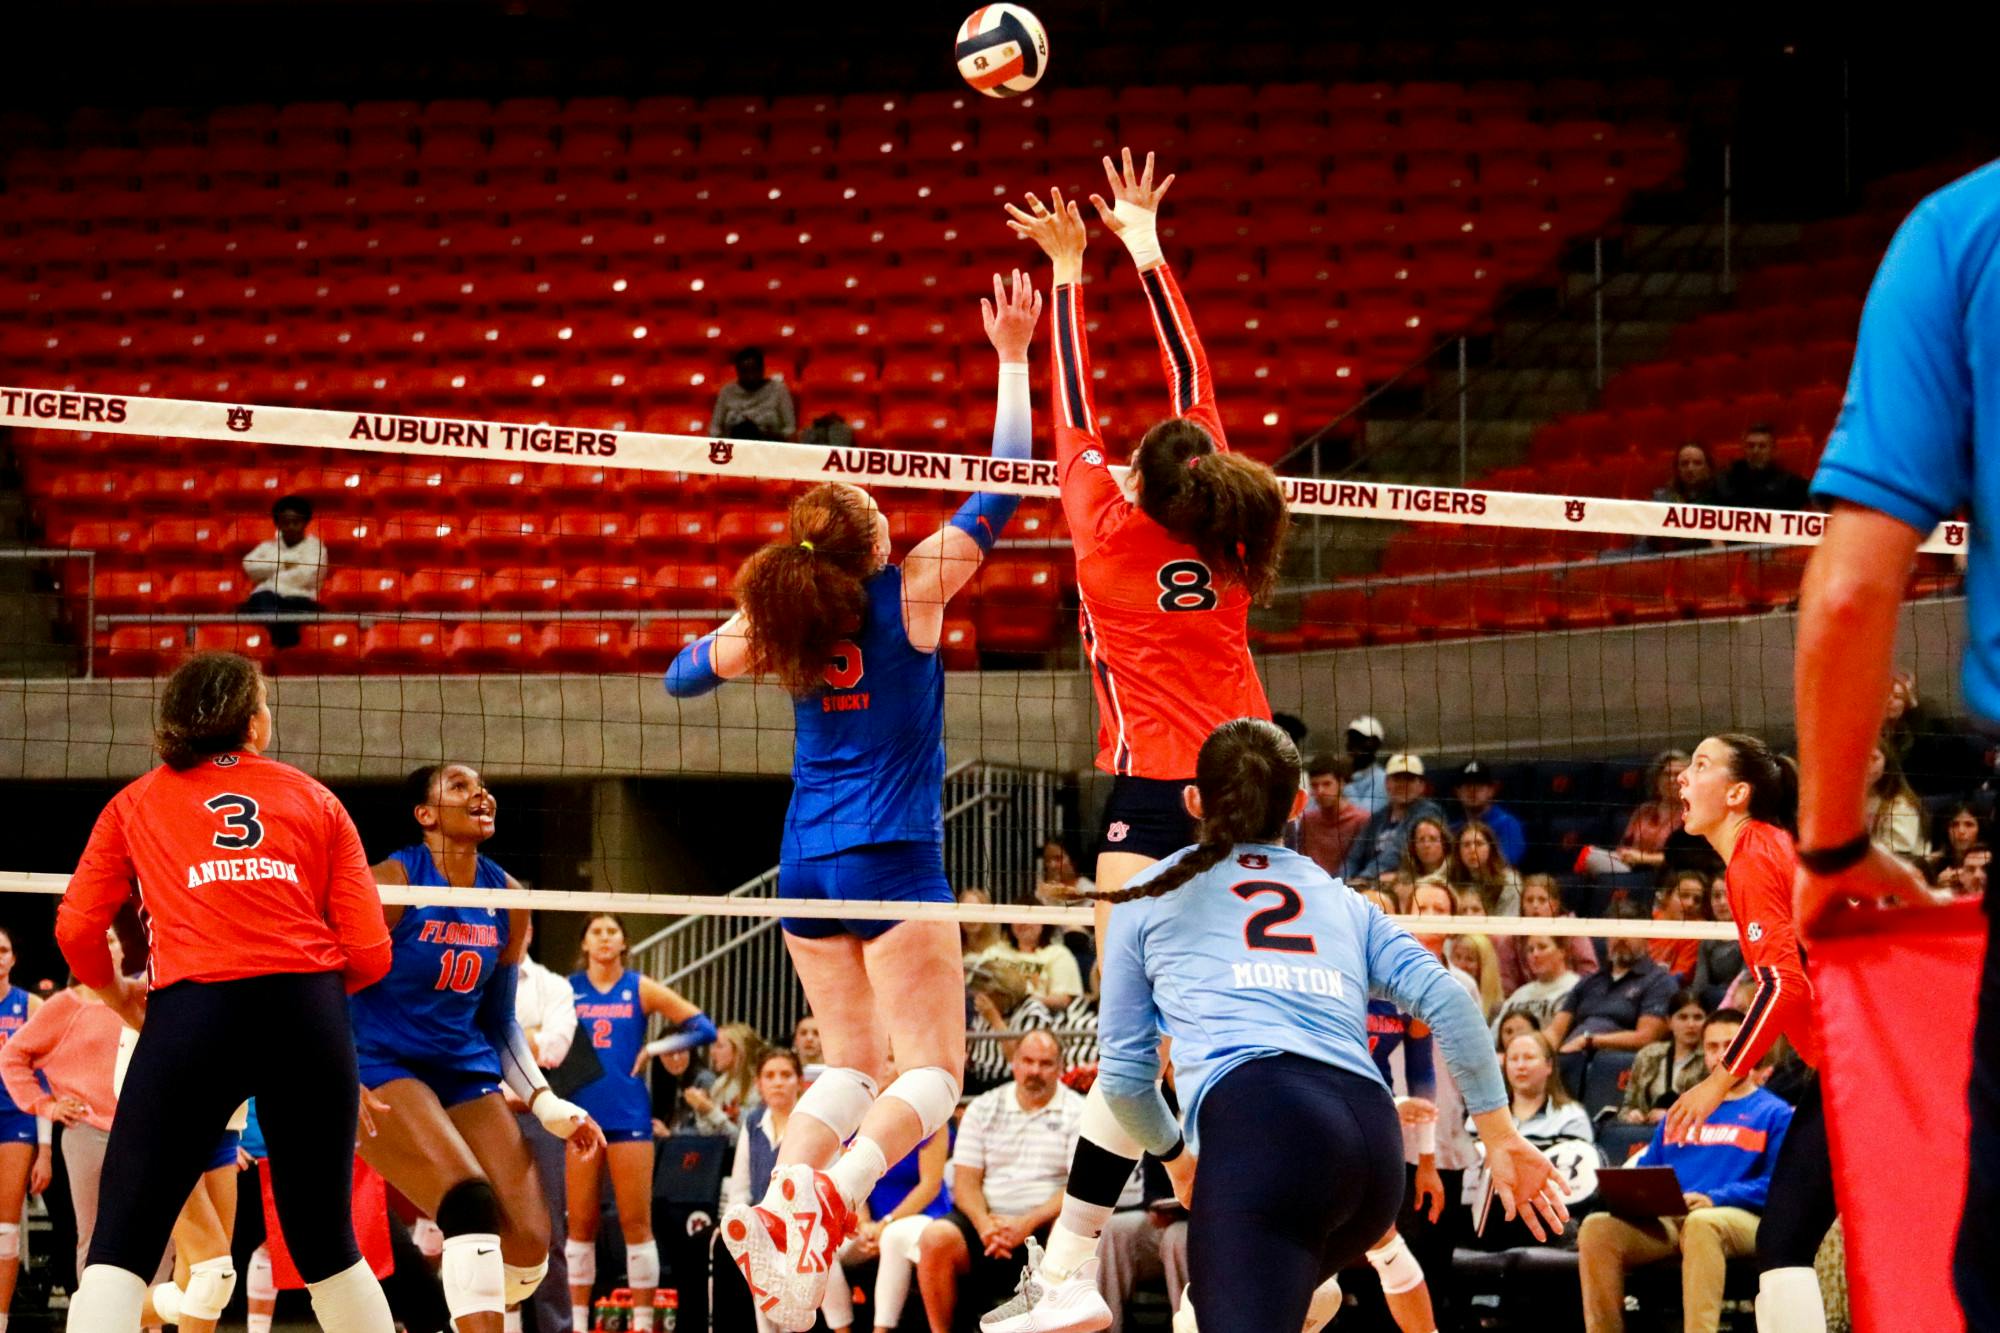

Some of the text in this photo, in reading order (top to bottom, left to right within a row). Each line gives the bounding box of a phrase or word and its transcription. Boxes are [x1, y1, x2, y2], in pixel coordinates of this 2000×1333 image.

[1, 390, 127, 423] TIGERS
[349, 415, 618, 456] AUBURN TIGERS
[822, 449, 950, 480] AUBURN
[1280, 481, 1488, 515] UBURN TIGERS
[1662, 506, 1829, 537] AUBURN TIG
[1157, 559, 1217, 612] 8
[823, 692, 870, 712] STUCKY
[203, 793, 264, 850] 3
[188, 857, 299, 888] ANDERSON
[418, 919, 498, 947] FLORIDA
[1229, 879, 1318, 955] 2
[434, 949, 482, 994] 10
[1231, 962, 1345, 998] MORTON
[592, 1019, 613, 1048] 2
